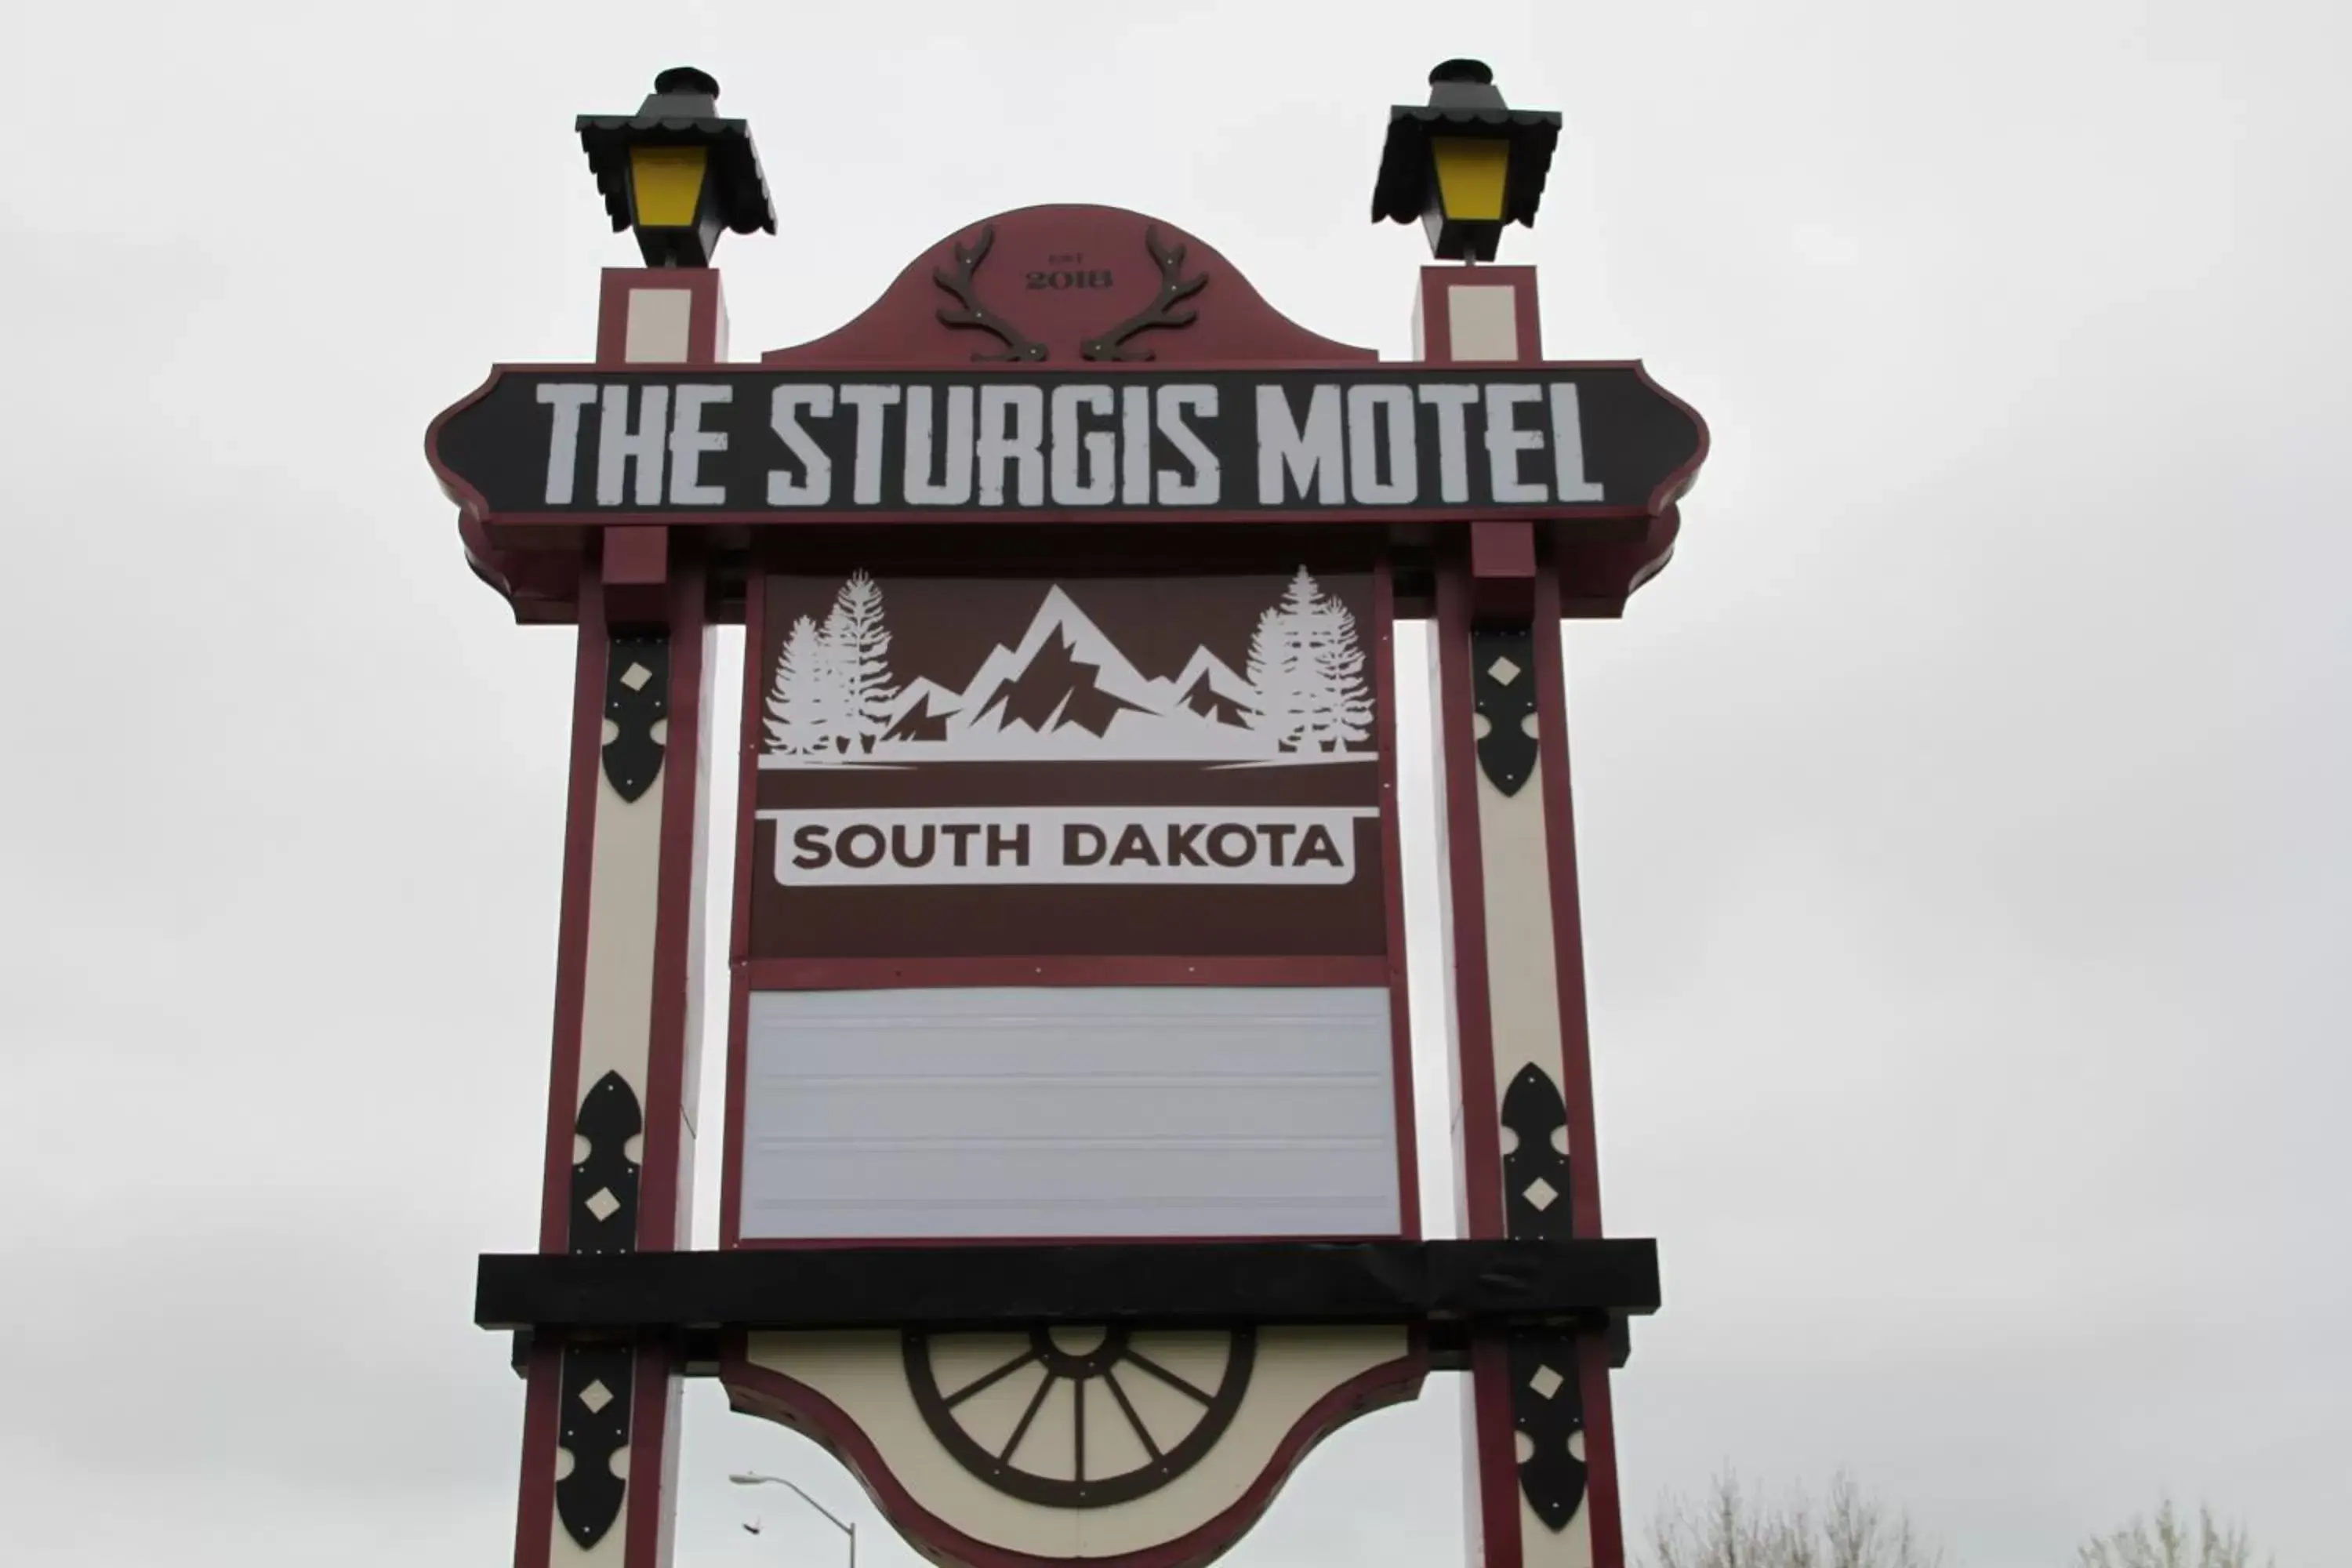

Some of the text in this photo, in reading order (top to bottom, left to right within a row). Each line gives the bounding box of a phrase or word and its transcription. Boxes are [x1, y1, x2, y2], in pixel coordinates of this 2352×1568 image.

[536, 383, 1604, 506] THE STURGIS MOTEL
[792, 822, 1344, 869] SOUTH DAKOTA
